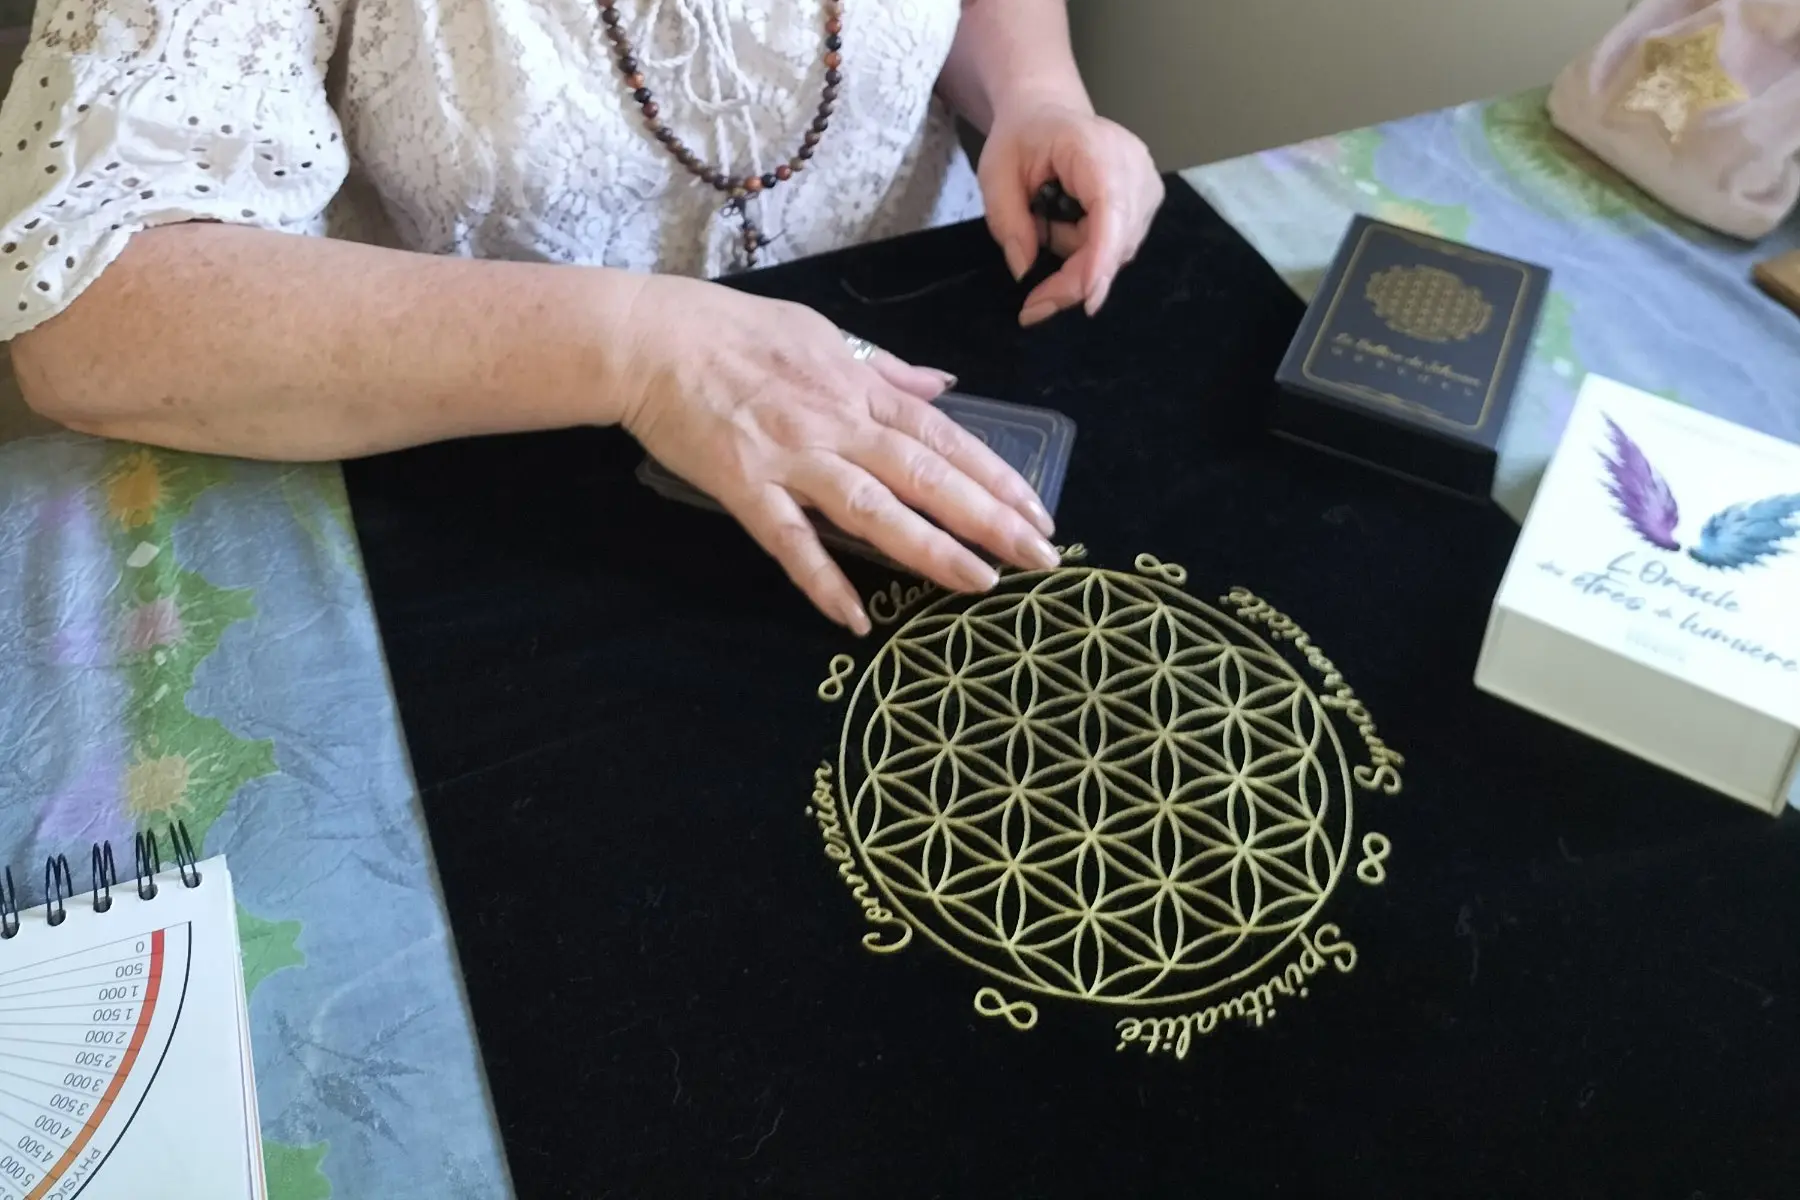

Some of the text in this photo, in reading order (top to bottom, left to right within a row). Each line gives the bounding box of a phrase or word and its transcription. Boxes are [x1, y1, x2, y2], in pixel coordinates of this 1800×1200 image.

[805, 760, 914, 954] Connexion
[115, 963, 143, 978] 500
[135, 940, 145, 953] 0
[1116, 923, 1358, 1059] Spiritualité
